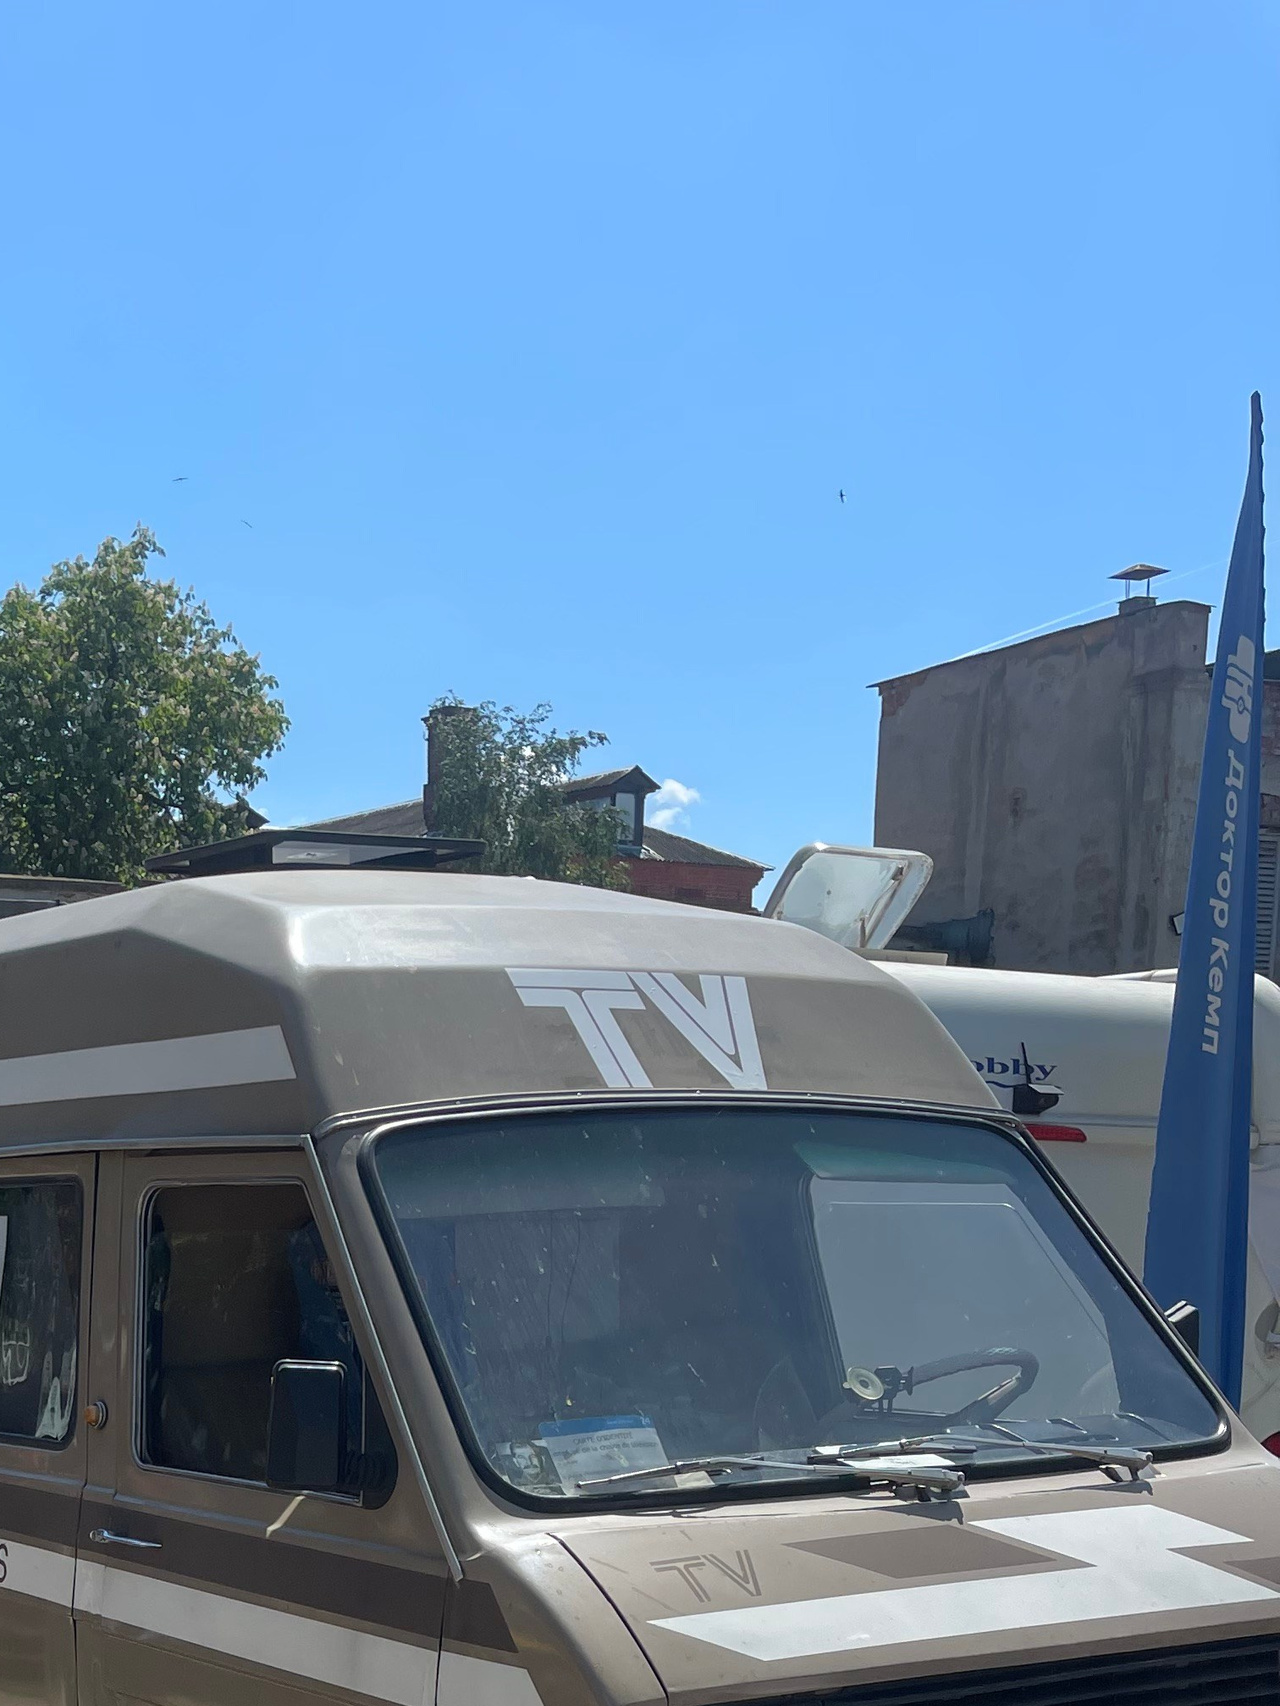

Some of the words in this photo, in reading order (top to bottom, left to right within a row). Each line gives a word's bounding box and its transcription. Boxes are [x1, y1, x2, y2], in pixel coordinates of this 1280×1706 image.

[1209, 747, 1246, 929] Доктор
[505, 966, 769, 1091] TV
[1200, 936, 1230, 1056] Кемп
[969, 1056, 1058, 1081] obby
[649, 1549, 762, 1604] TV
